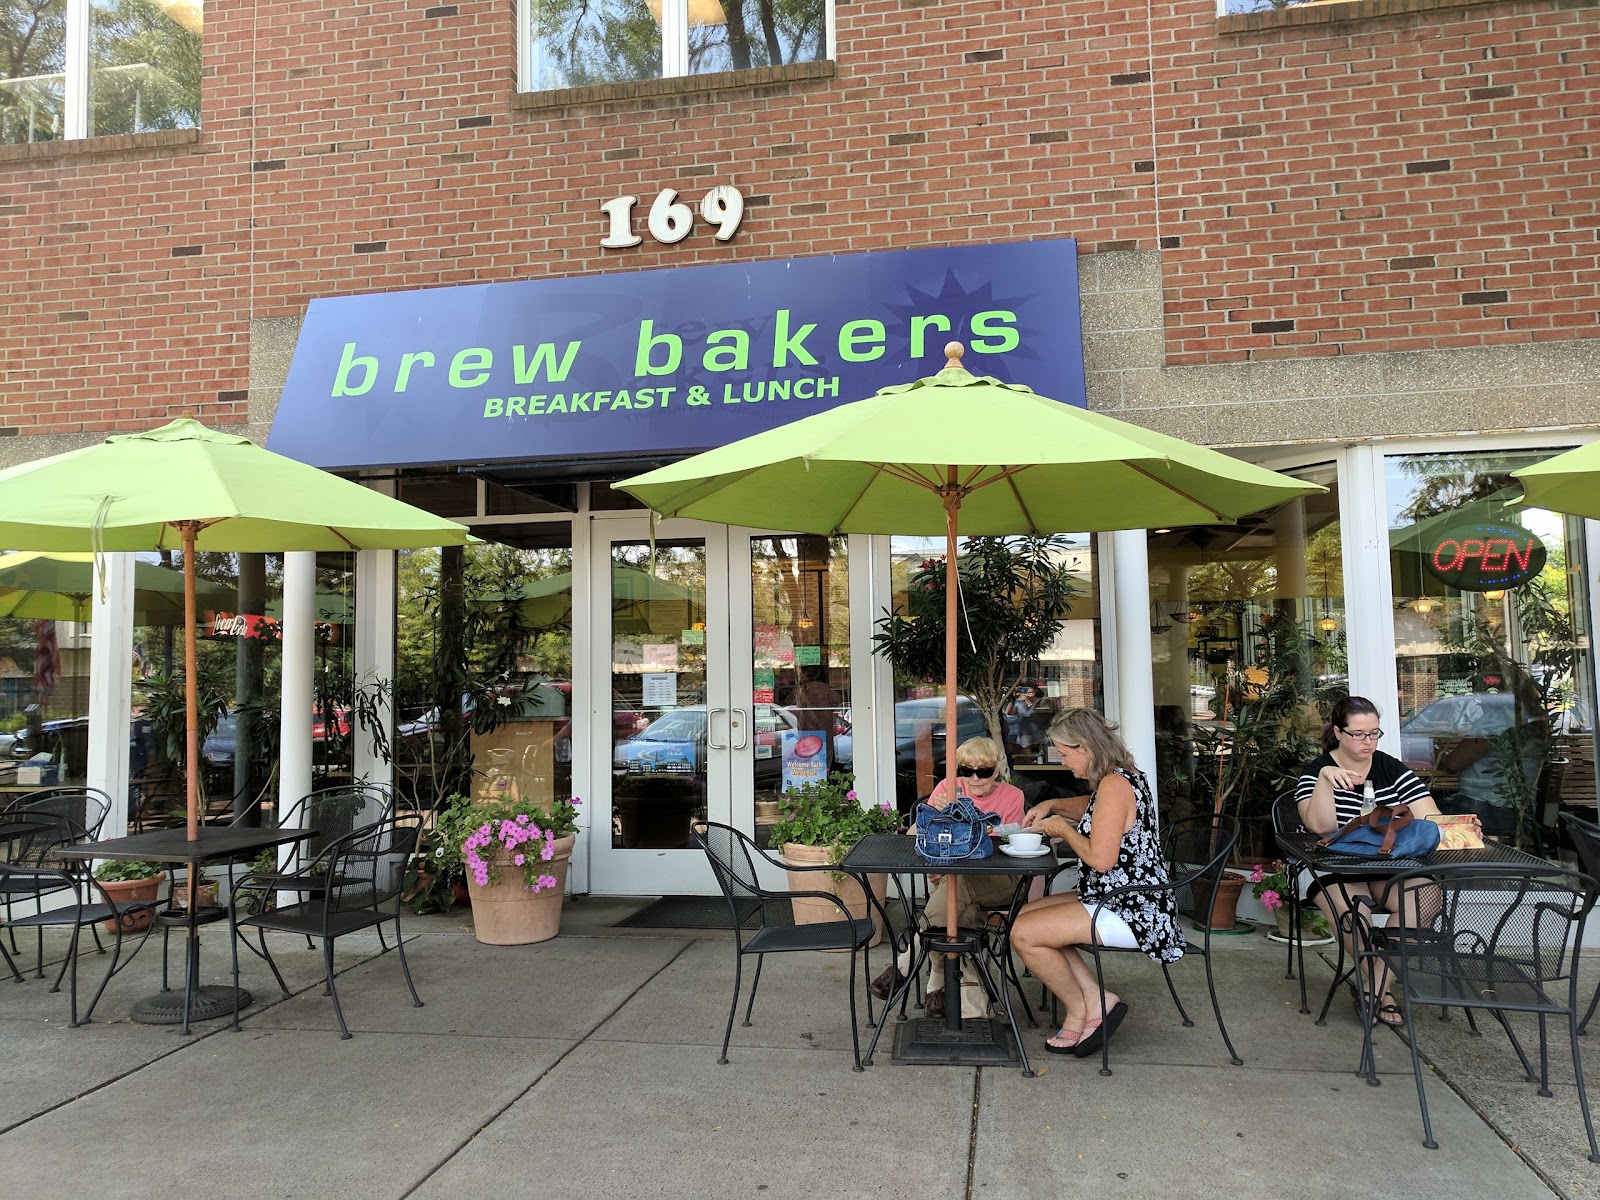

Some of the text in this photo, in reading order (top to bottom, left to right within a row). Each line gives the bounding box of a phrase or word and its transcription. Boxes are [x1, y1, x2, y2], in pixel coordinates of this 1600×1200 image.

[600, 184, 745, 248] 169
[331, 307, 1021, 398] brew bakers
[483, 387, 677, 418] BREAKFAST
[686, 385, 712, 407] &
[723, 376, 840, 404] LUNCH
[1433, 538, 1534, 572] OPEN
